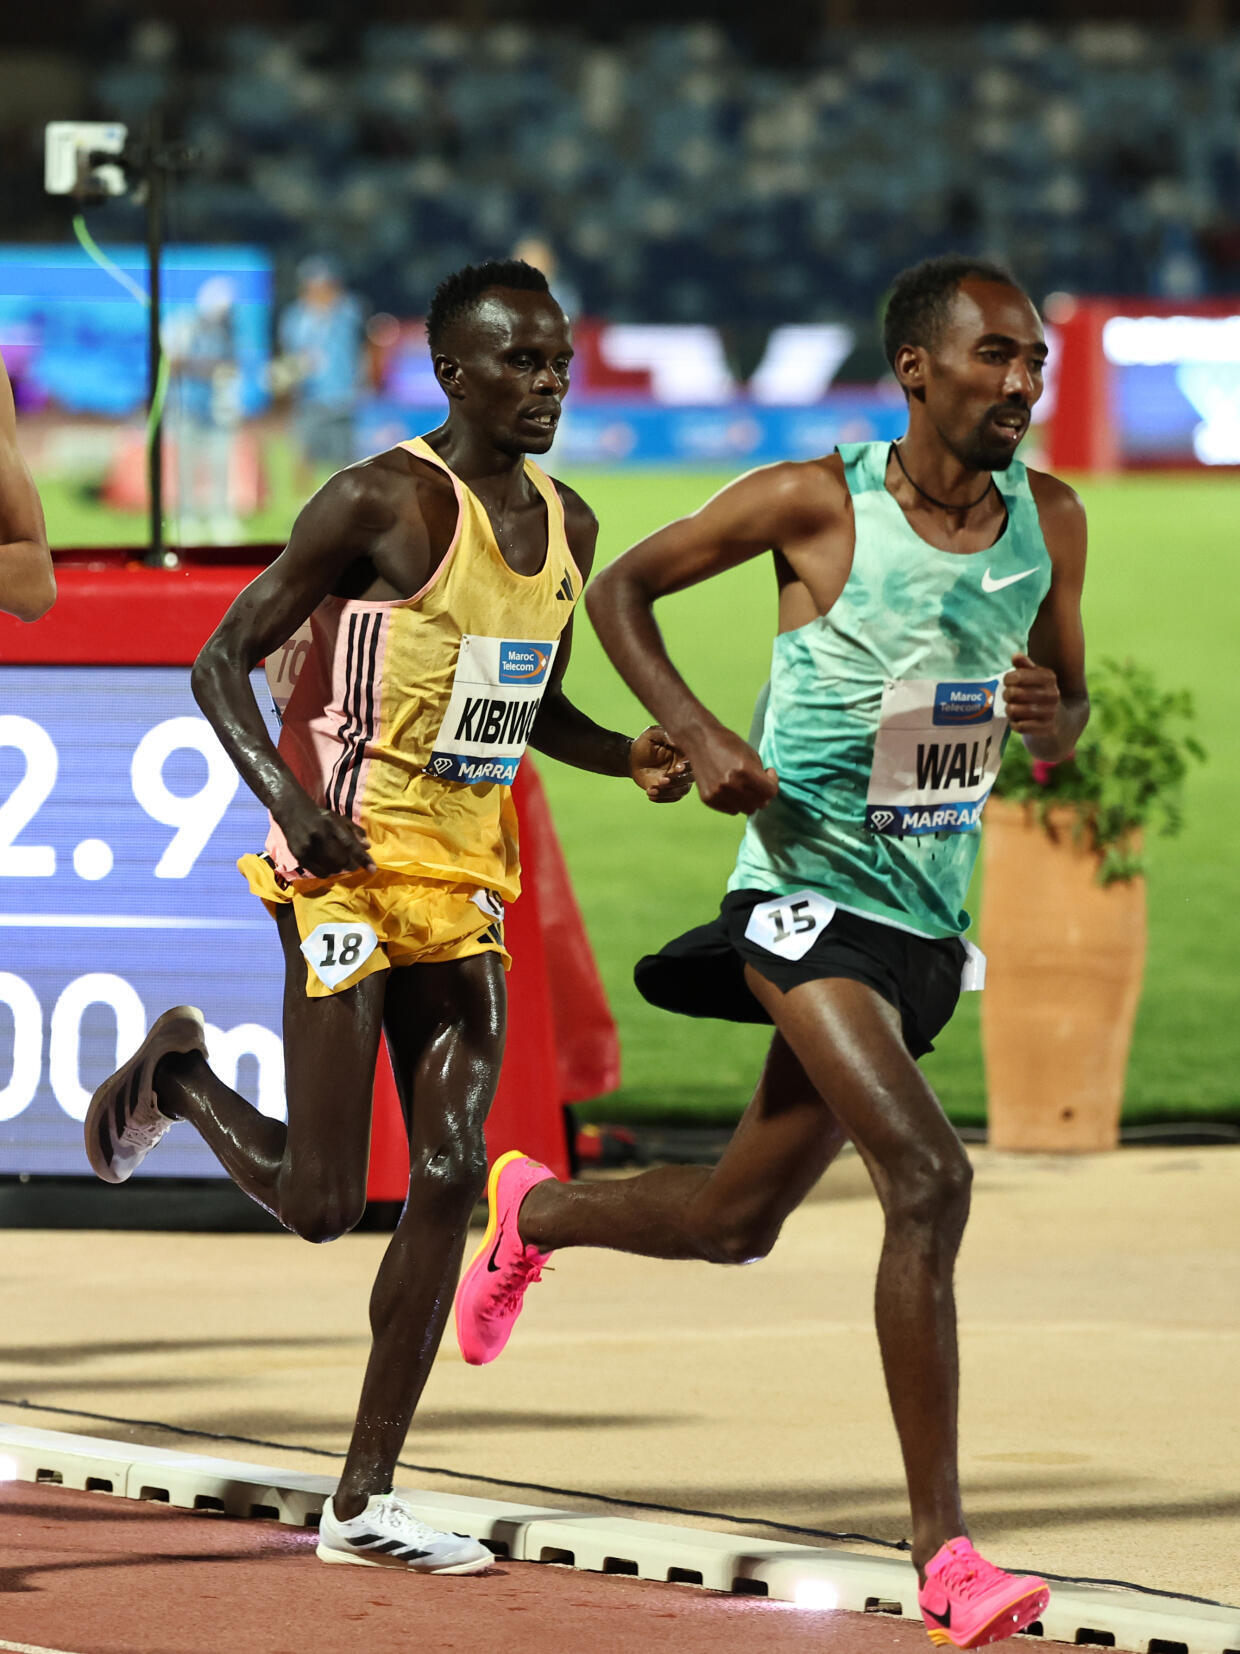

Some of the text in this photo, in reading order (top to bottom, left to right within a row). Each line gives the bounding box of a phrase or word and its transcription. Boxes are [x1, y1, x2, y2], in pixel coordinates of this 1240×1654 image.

[502, 660, 534, 671] Telecom
[508, 651, 534, 661] Maroc
[950, 691, 983, 701] Maroc
[917, 735, 992, 790] WAL
[767, 900, 817, 943] 15
[319, 933, 363, 967] 18
